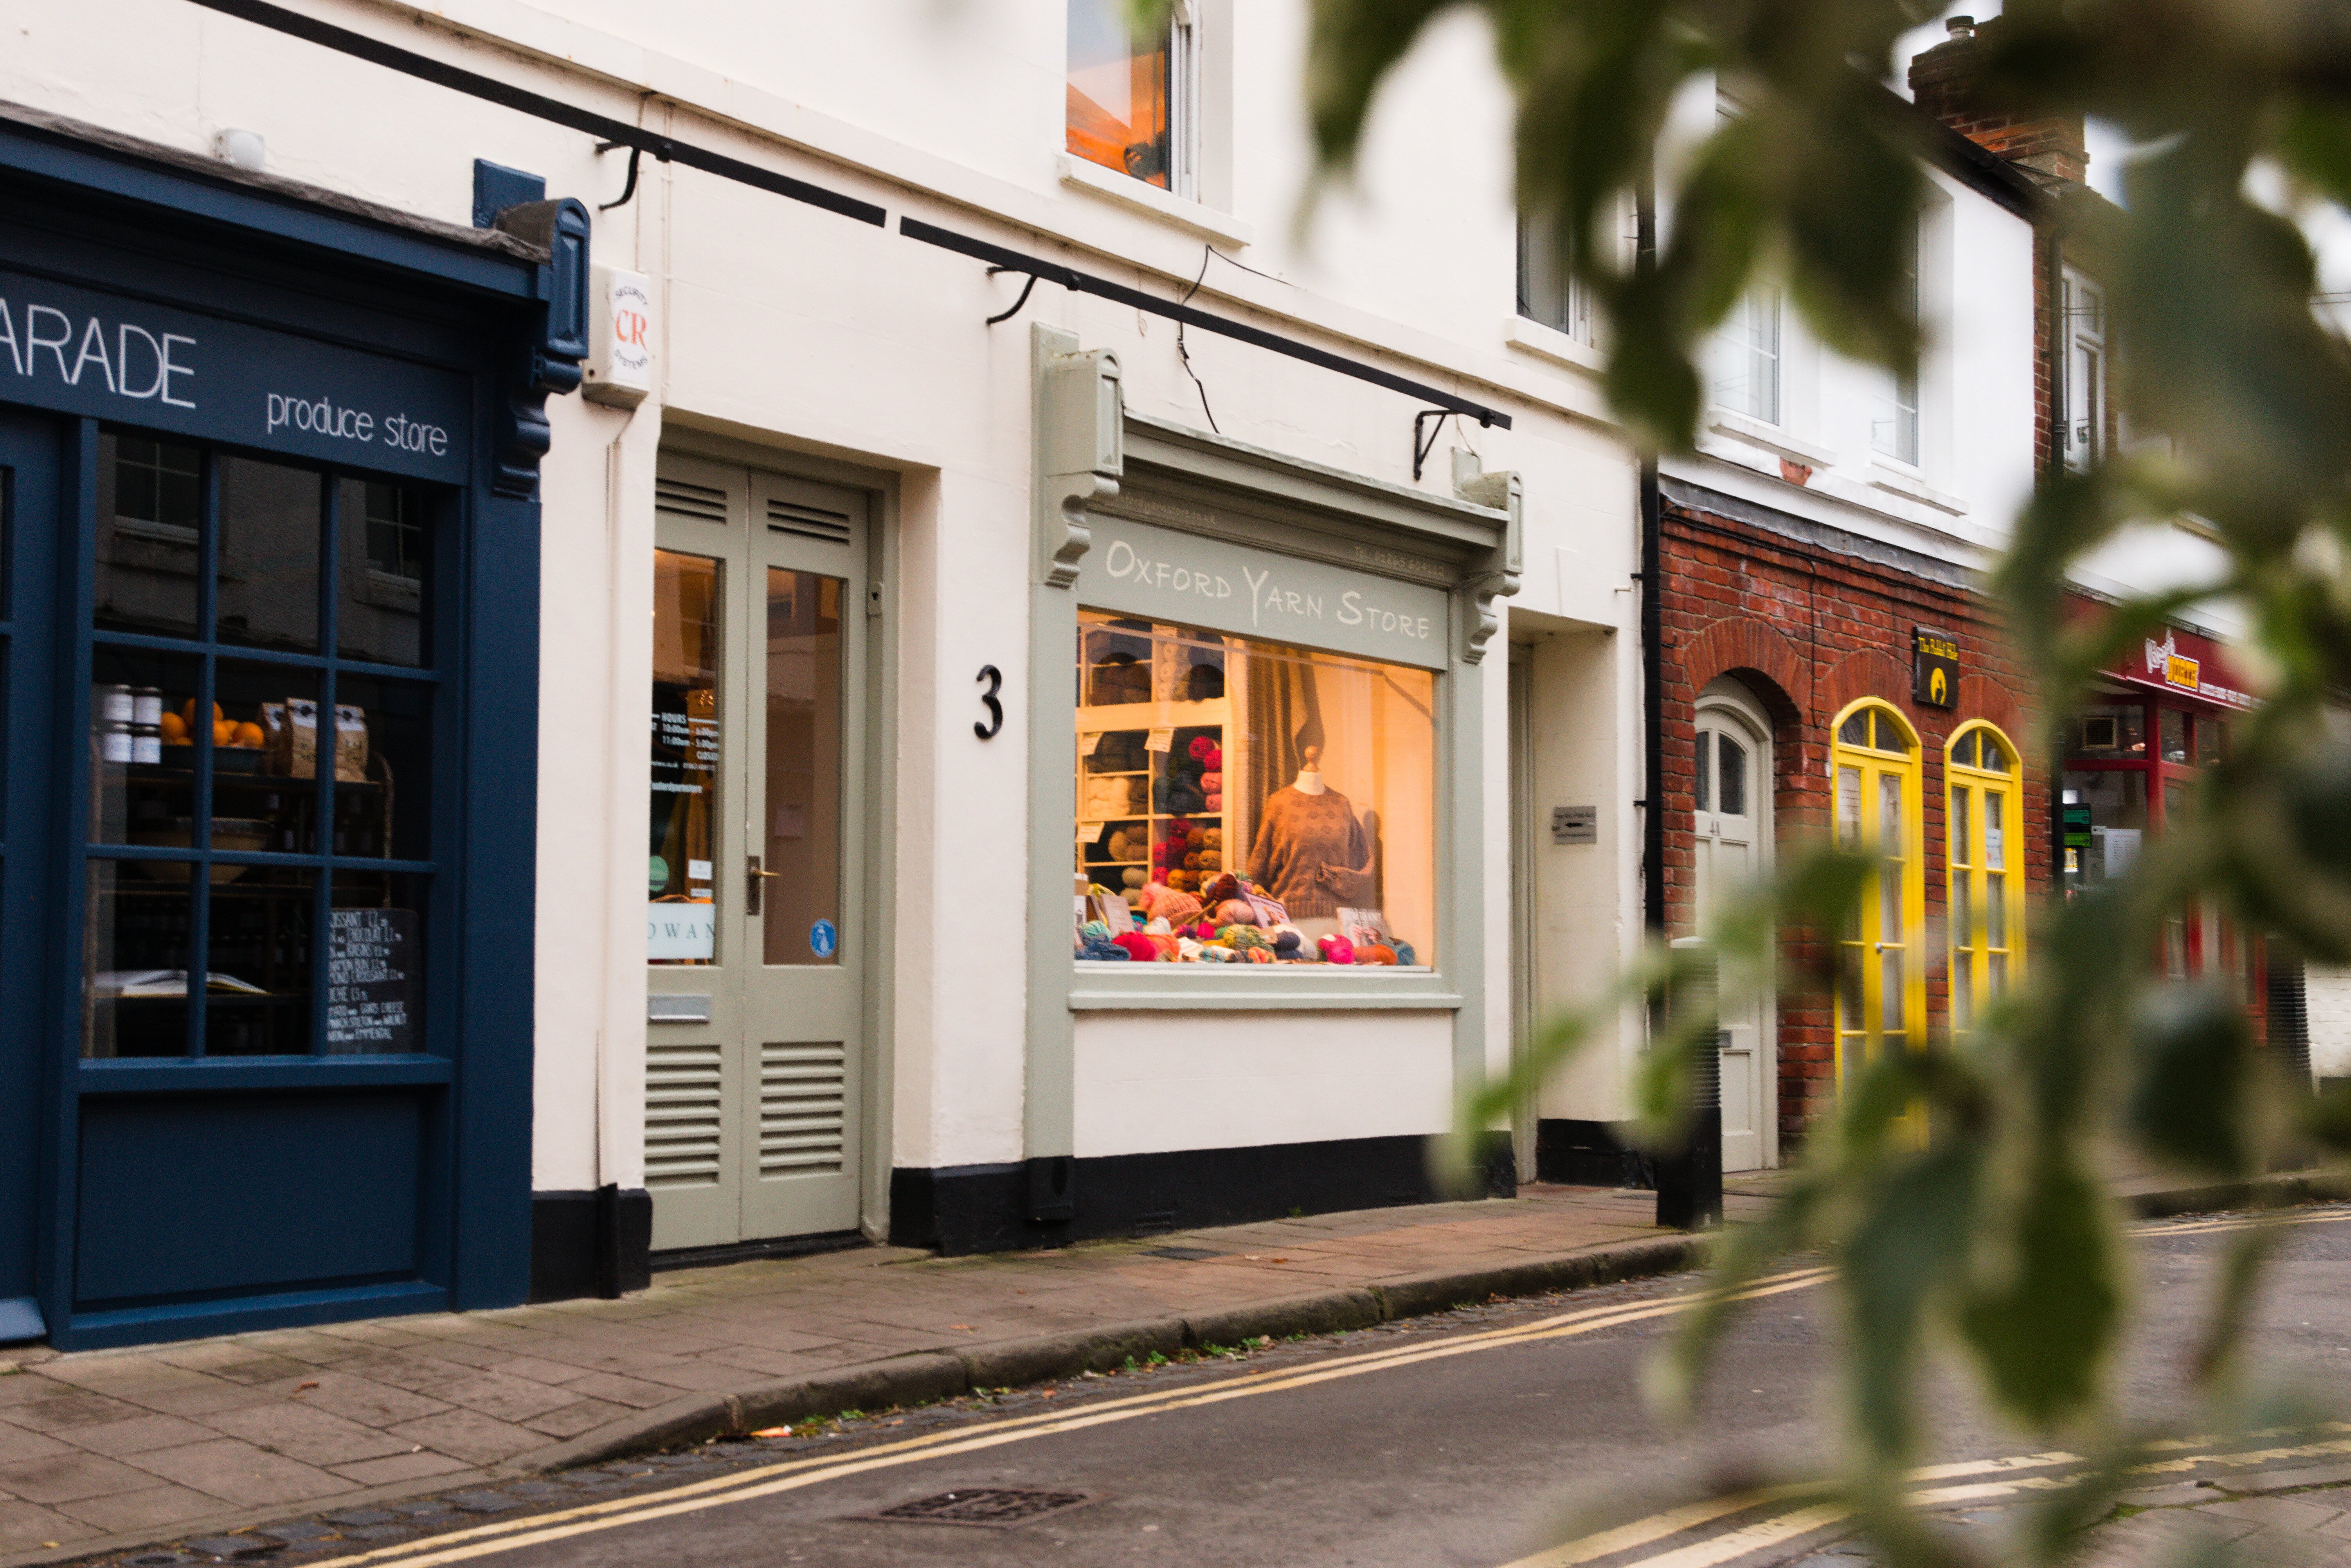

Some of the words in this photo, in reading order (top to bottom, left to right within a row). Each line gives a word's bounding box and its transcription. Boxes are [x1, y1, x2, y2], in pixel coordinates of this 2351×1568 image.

[615, 286, 648, 308] SECURITY
[616, 309, 648, 352] CR
[614, 348, 648, 369] SYSTEMS
[267, 393, 373, 442] produce
[385, 405, 447, 456] store
[1106, 540, 1231, 599] OXFORD
[1242, 566, 1323, 627] YARN
[1336, 591, 1430, 638] STORE
[662, 712, 686, 724] HOURS
[974, 664, 1003, 739] 3
